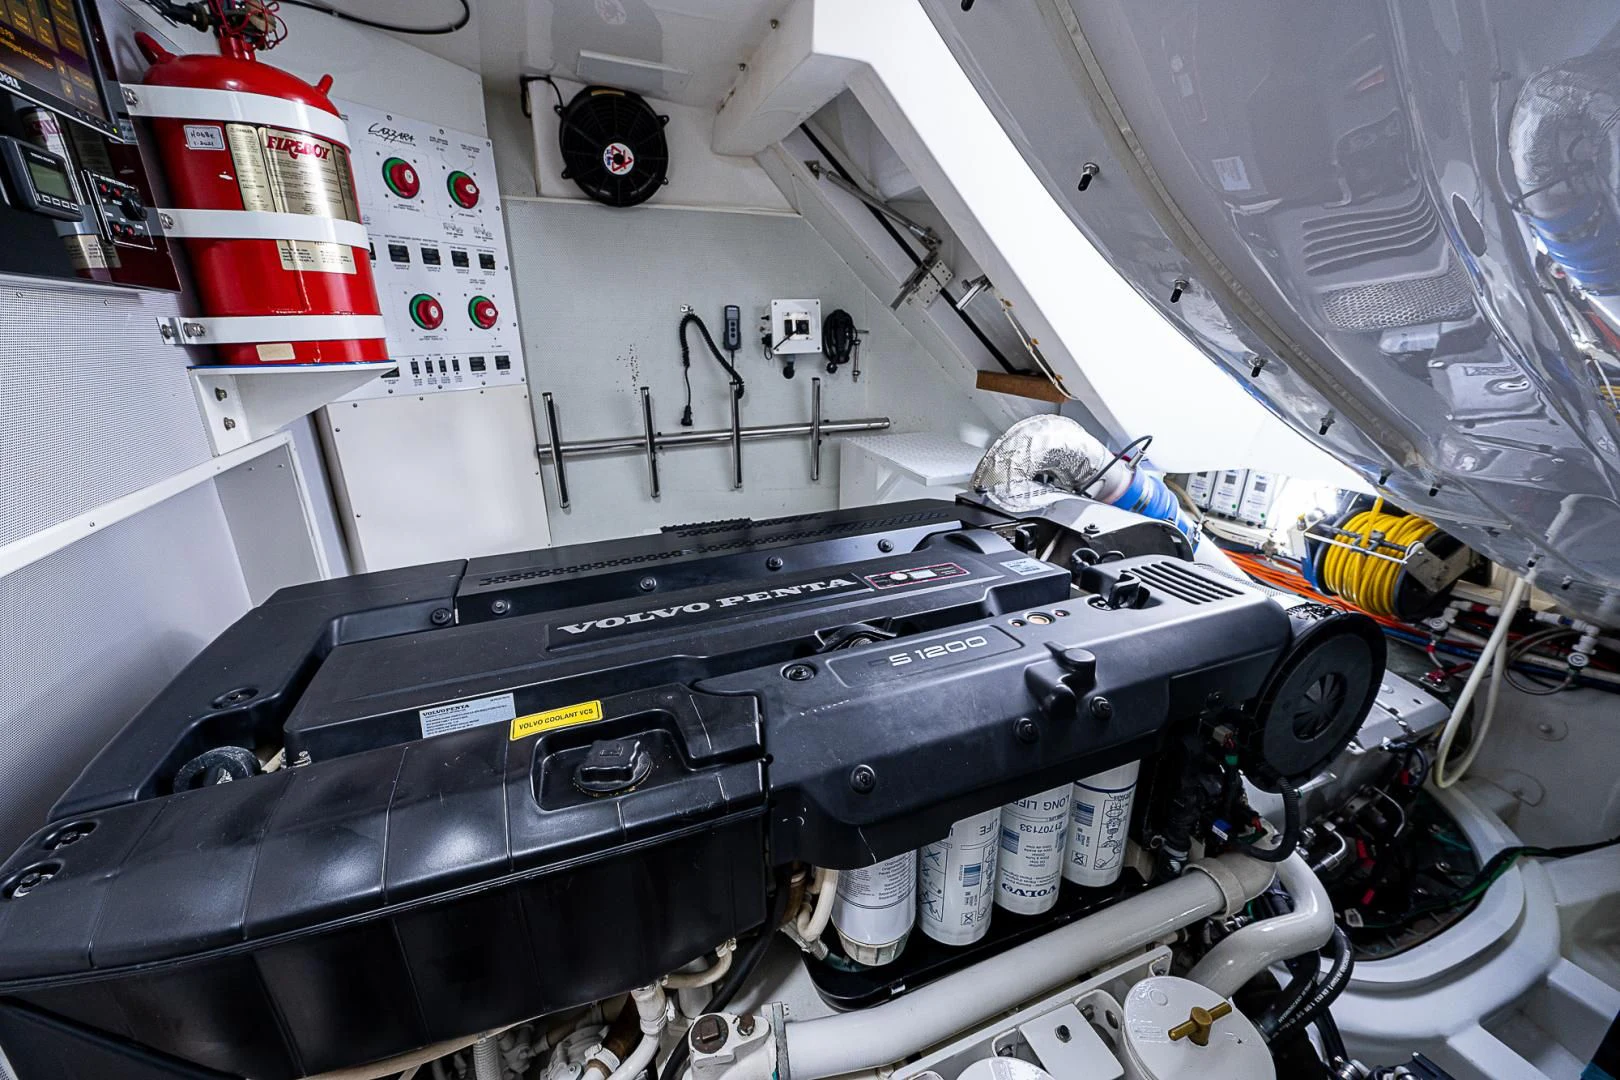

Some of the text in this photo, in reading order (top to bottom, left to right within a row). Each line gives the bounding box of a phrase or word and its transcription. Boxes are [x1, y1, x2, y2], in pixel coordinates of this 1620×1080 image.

[266, 135, 330, 160] FIREBOY
[556, 578, 857, 635] VOLVO PENTA
[888, 635, 988, 667] S 1200
[519, 708, 594, 730] VOLVO COOLANT VCS
[1043, 794, 1070, 811] LONG
[979, 818, 998, 836] LIFE
[1020, 821, 1063, 834] 21707133
[1001, 883, 1057, 898] VOLVO
